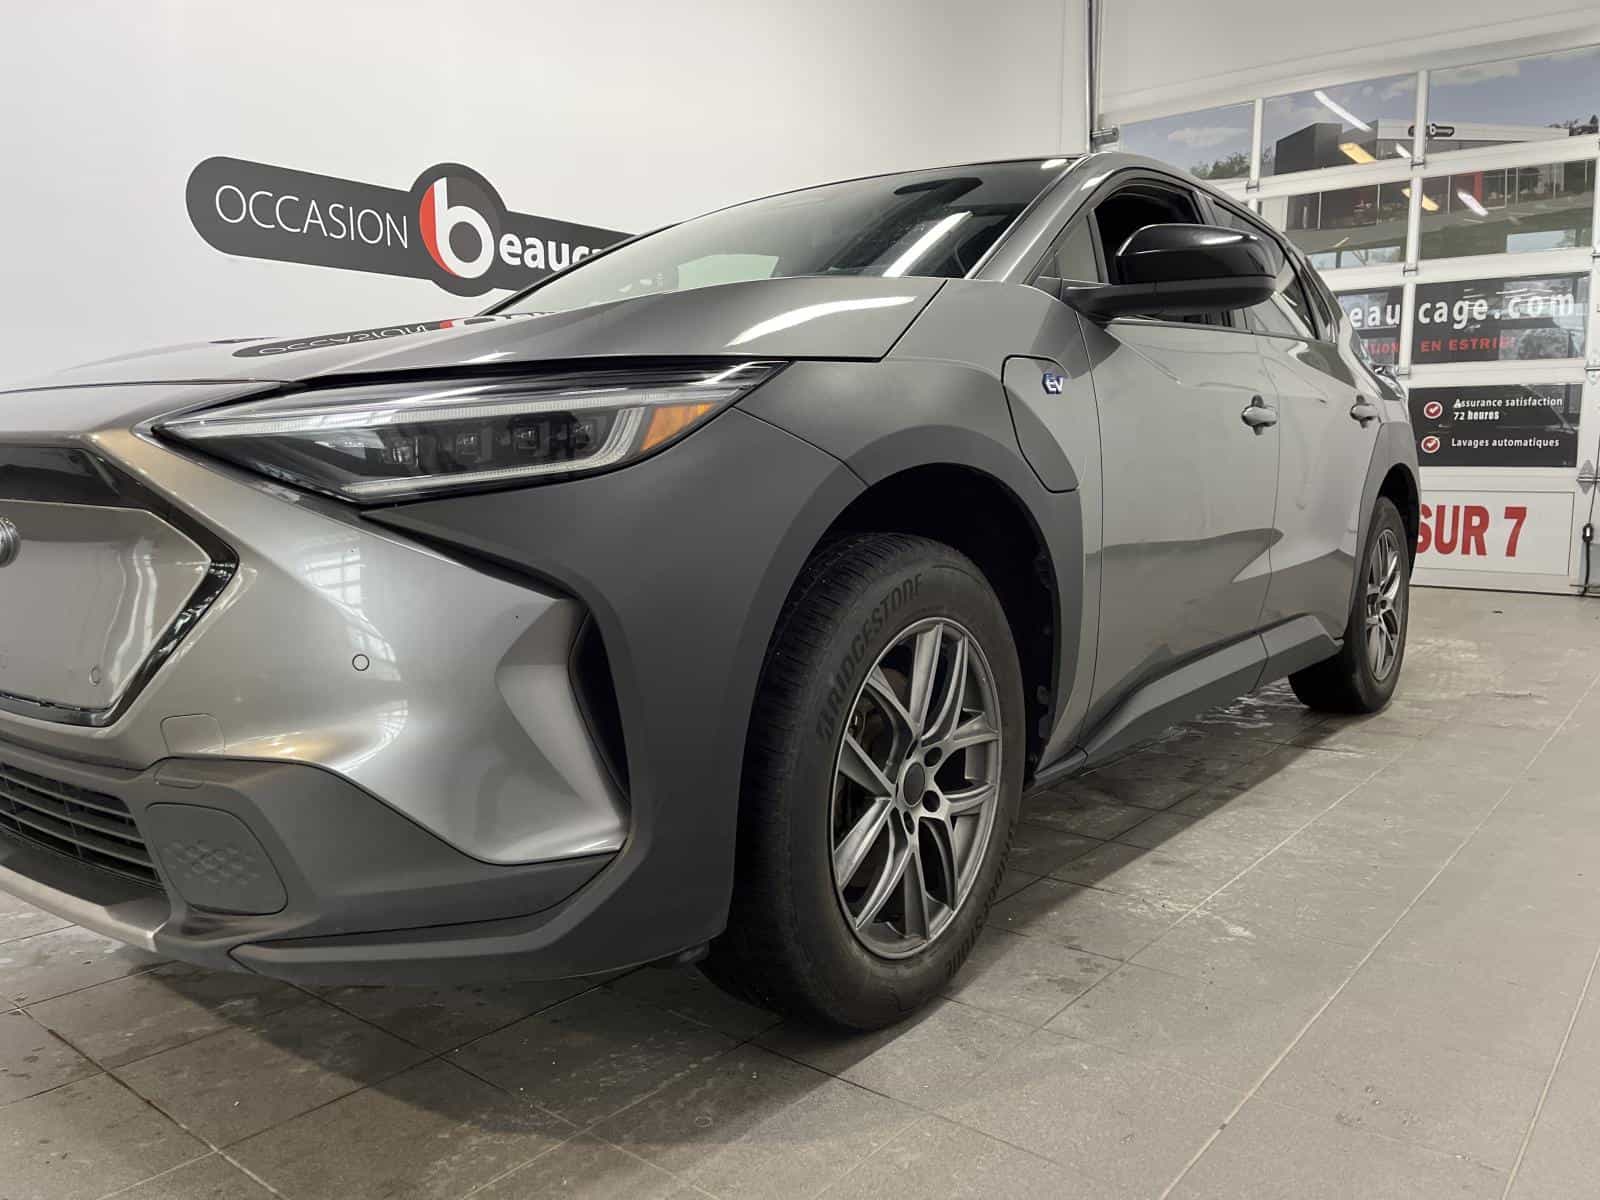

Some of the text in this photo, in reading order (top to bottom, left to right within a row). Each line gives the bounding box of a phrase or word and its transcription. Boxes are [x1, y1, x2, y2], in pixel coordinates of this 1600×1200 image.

[215, 185, 408, 249] OCCASION
[1420, 340, 1442, 353] EN
[1043, 373, 1064, 394] EV
[1453, 396, 1563, 409] Assurance satisfaction
[1453, 410, 1500, 421] 72 heures
[1451, 437, 1560, 449] Lavages automatiques
[1504, 506, 1527, 557] 7
[815, 572, 923, 744] BRIDGESTONE
